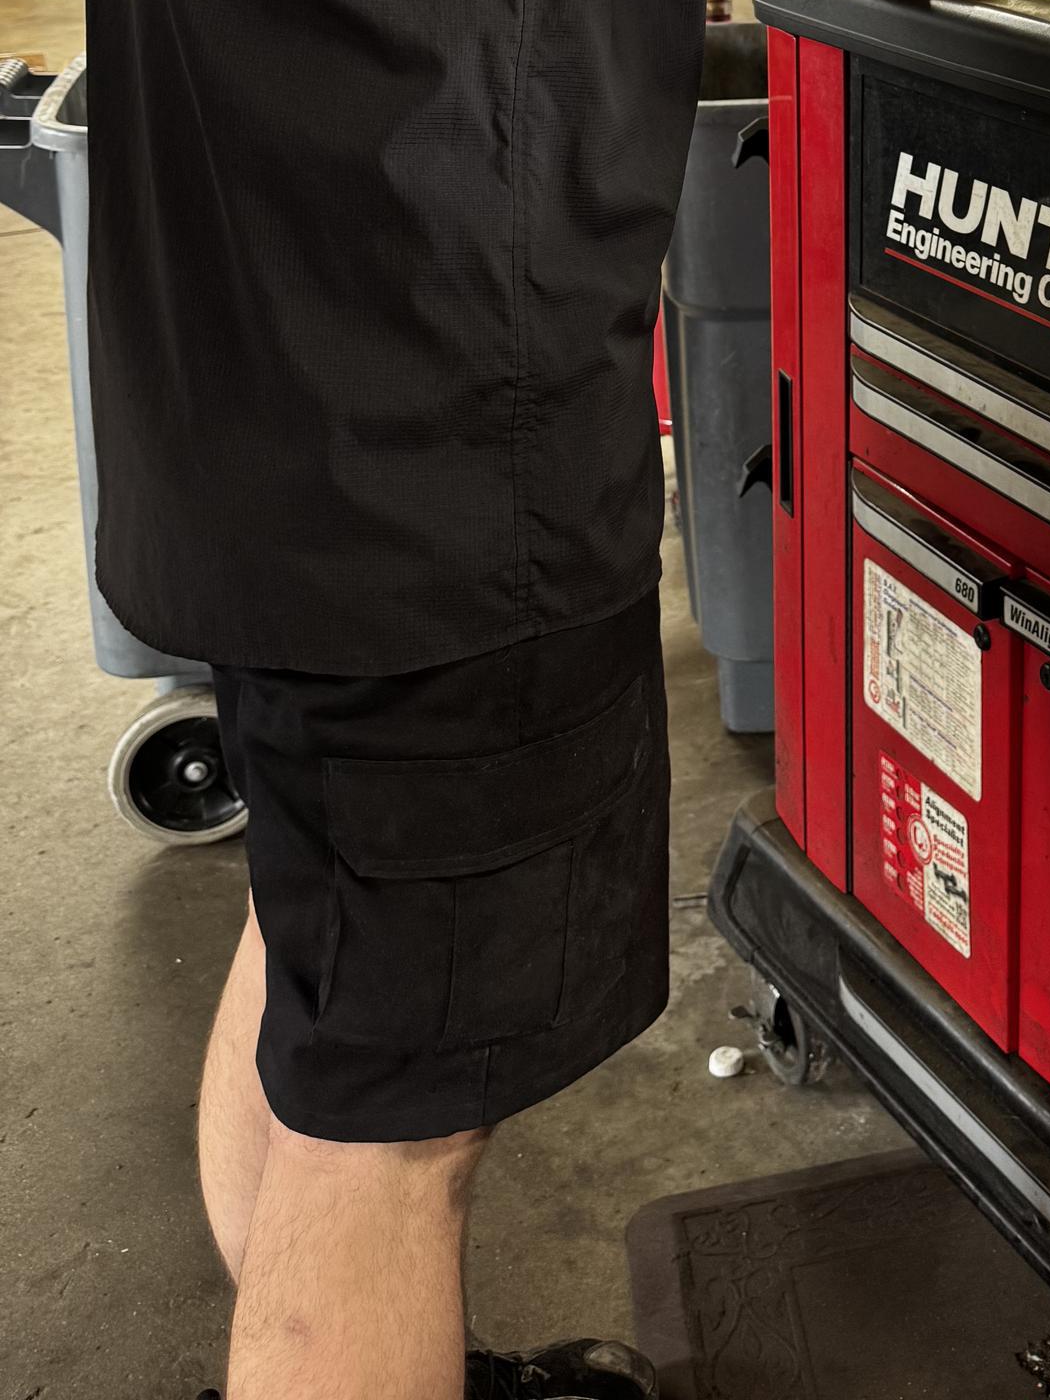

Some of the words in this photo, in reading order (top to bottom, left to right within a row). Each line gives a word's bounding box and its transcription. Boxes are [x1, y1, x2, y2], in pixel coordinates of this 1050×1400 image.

[886, 209, 1033, 304] Engineering
[955, 577, 975, 603] 680
[925, 796, 965, 835] Alignment
[925, 809, 964, 847] Specialist
